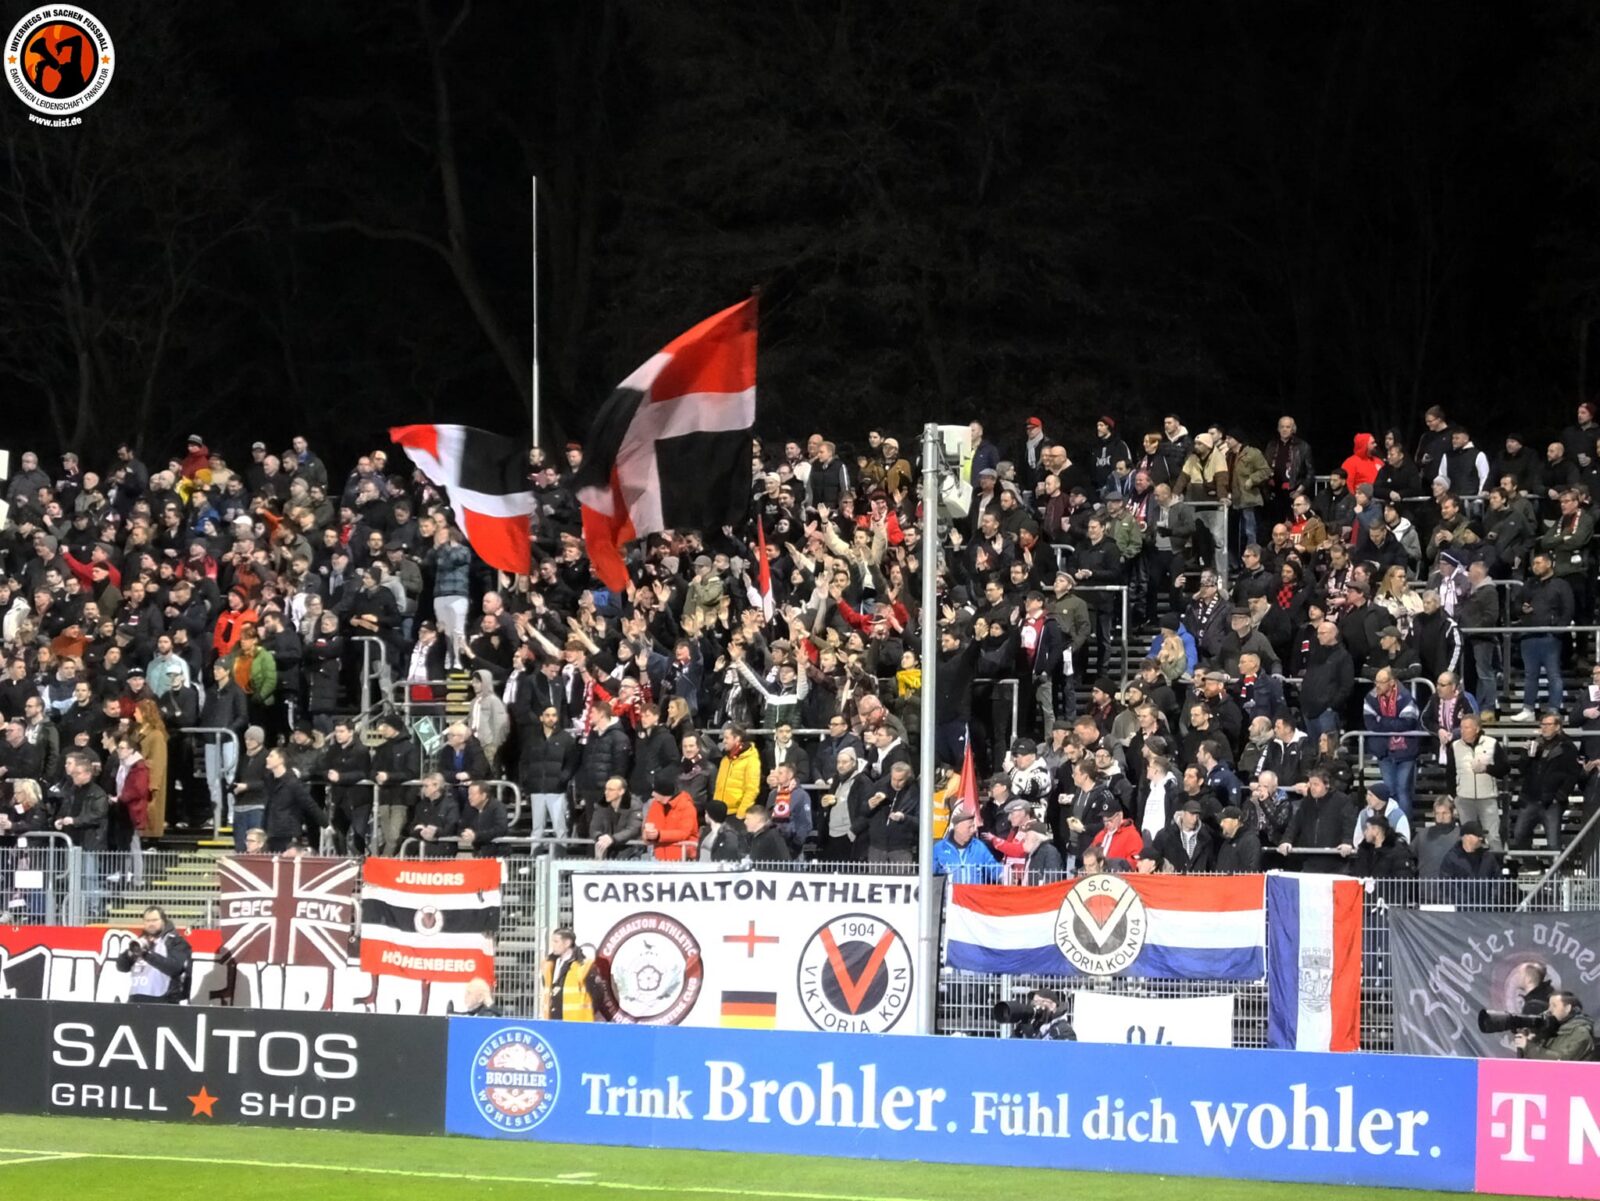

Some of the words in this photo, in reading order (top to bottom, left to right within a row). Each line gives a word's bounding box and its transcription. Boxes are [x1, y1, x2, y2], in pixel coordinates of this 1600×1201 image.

[395, 871, 464, 886] JUNIORS
[584, 879, 777, 902] CARSHALTON
[787, 881, 919, 905] ATHLETI
[1088, 879, 1112, 892] S.C.
[296, 901, 343, 922] FCVK
[602, 918, 658, 957] CARSHALTON
[658, 920, 697, 956] ATHLETIC
[841, 923, 875, 937] 1904
[1058, 920, 1104, 972] VIKTORIA
[1106, 938, 1138, 971] KÖLN
[381, 950, 477, 972] HÖHENBERG
[804, 965, 871, 1033] VIKTORIA
[878, 967, 907, 1022] KÖLN
[53, 1014, 359, 1079] SANTOS
[535, 1042, 554, 1070] DES
[485, 1071, 548, 1087] BROHLER
[51, 1082, 168, 1112] GRILL
[240, 1092, 356, 1120] SHOP
[478, 1089, 553, 1127] WOHLSEINS
[581, 1072, 694, 1120] Trink
[702, 1060, 958, 1133] Brohler.
[970, 1091, 1071, 1139] Fühl
[1081, 1094, 1179, 1144] dich
[1190, 1082, 1441, 1158] wohler.
